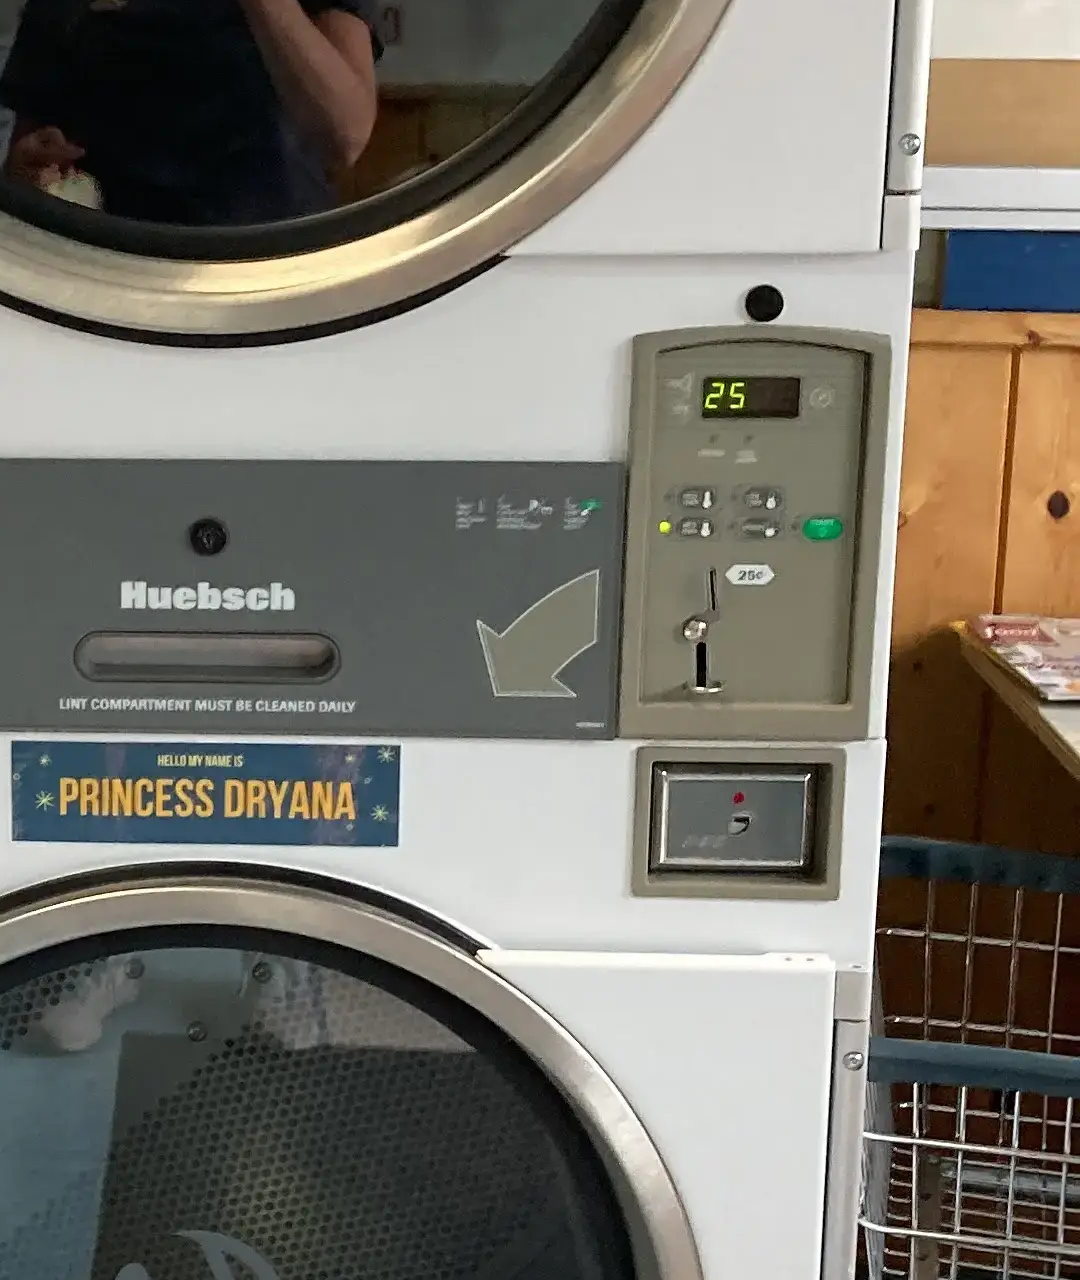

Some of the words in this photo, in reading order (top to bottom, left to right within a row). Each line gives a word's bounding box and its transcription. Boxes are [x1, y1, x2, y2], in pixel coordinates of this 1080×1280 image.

[704, 382, 745, 409] 25
[120, 581, 296, 611] Huebsch
[60, 698, 88, 710] LINT
[91, 699, 192, 711] COMPARTMENT
[195, 700, 233, 712] MUST
[236, 700, 253, 712] BE
[255, 700, 316, 713] CLEANED
[319, 701, 356, 713] DAILY
[157, 754, 187, 767] HELLO
[188, 754, 204, 767] MY
[205, 755, 232, 767] NAME
[234, 755, 244, 768] IS
[59, 777, 214, 818] PRINCESS
[224, 779, 356, 820] DRYANA
